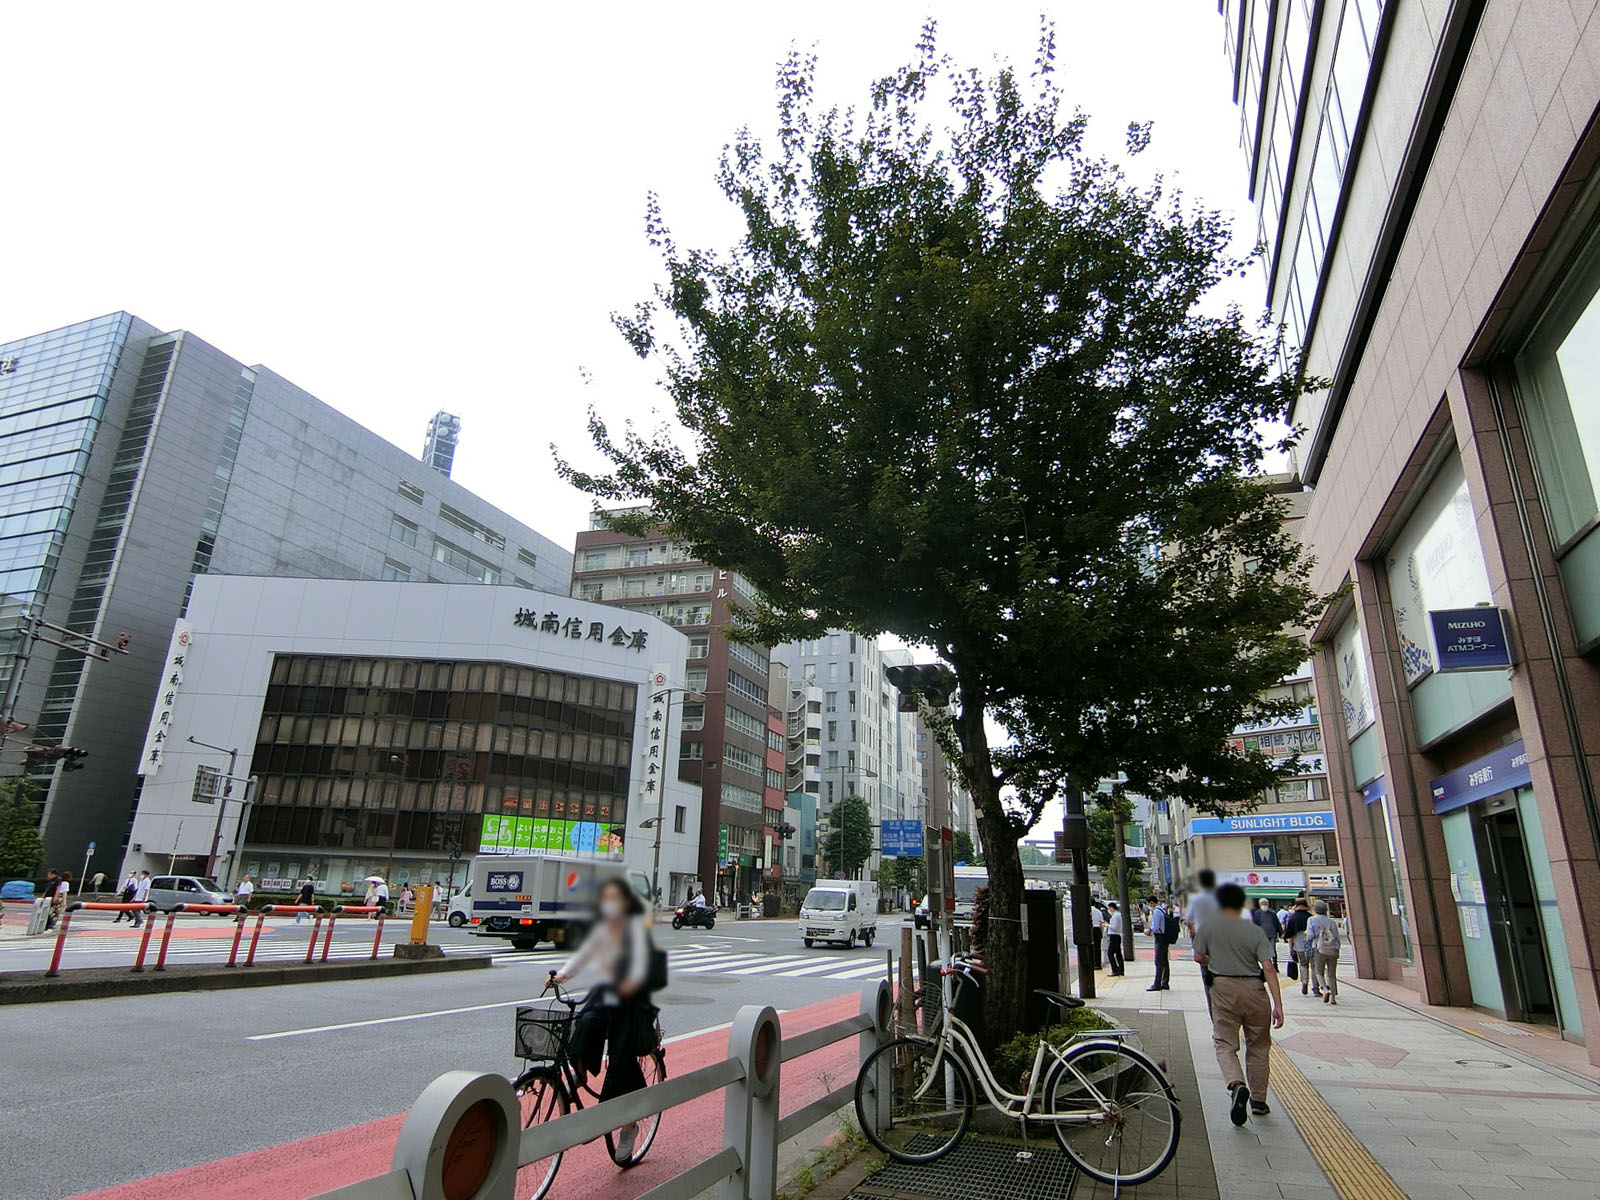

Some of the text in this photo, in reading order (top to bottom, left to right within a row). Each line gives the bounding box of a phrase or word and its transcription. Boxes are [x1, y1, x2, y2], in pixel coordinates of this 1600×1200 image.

[514, 606, 649, 653] 城南信用金庫
[1448, 620, 1486, 630] MIZUHO
[1457, 635, 1482, 644] みずほ
[1448, 643, 1496, 652] ATMコーナー
[149, 653, 184, 766] 城南信用金庫
[1231, 815, 1327, 830] SUNLIGHT BLDG.
[515, 833, 564, 844] ネットワーク
[490, 877, 508, 886] BOSS
